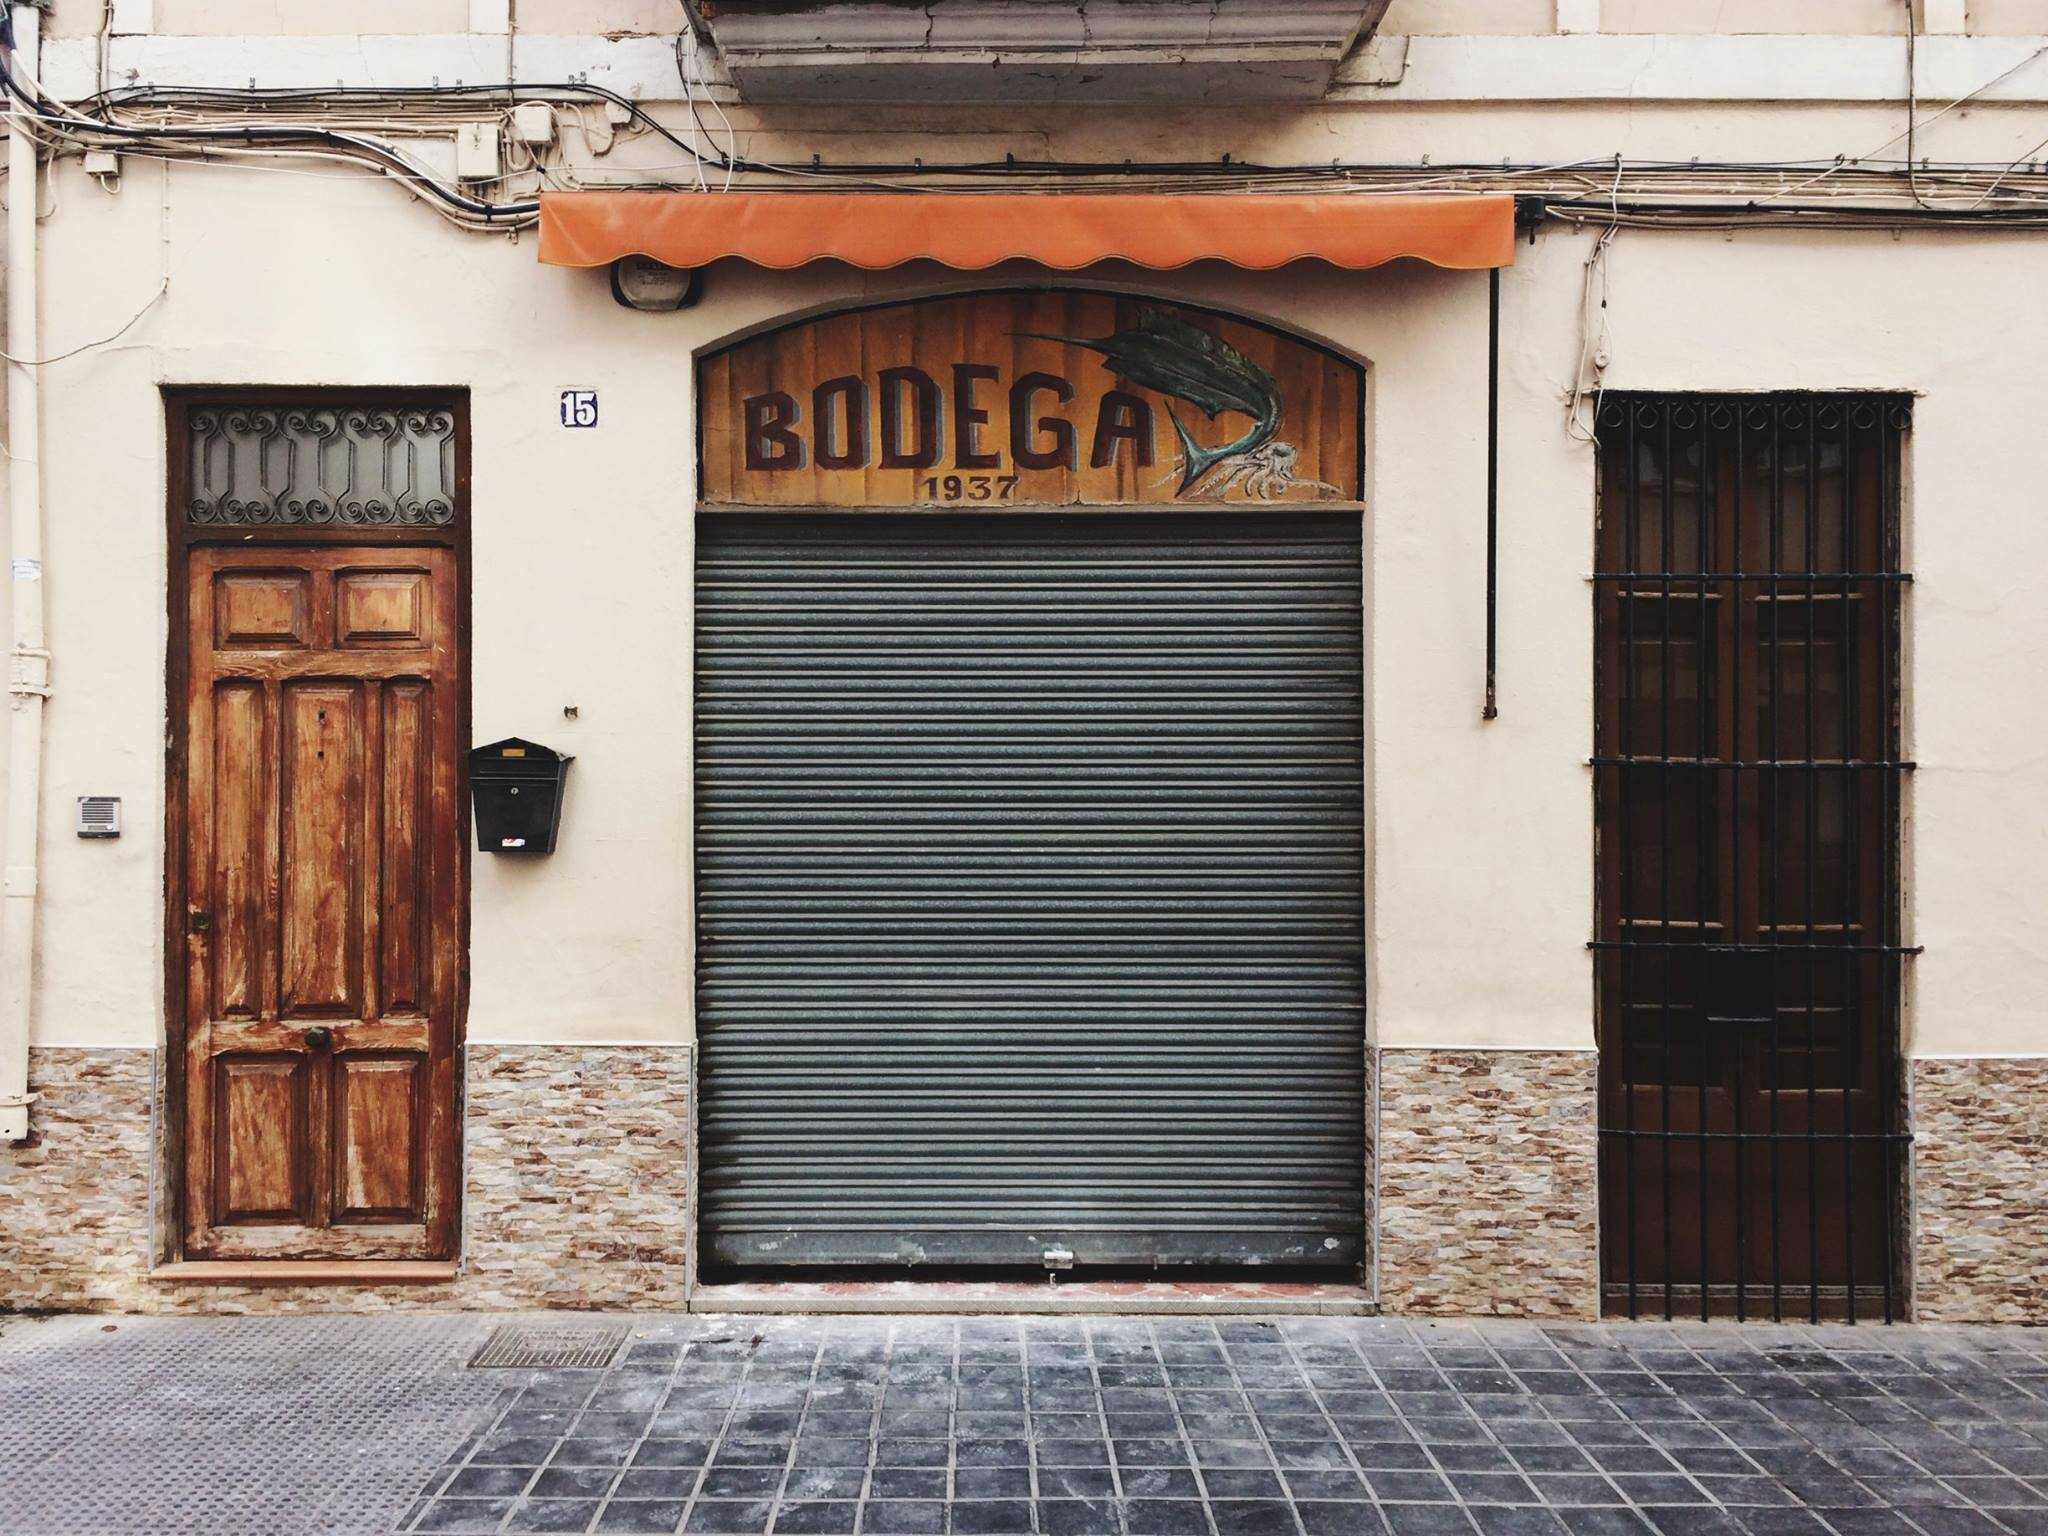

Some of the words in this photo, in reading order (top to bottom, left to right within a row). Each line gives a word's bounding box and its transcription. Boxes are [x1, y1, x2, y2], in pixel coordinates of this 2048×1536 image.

[561, 392, 597, 425] 15
[744, 363, 1154, 472] BODEGA
[922, 475, 1019, 501] 1937
